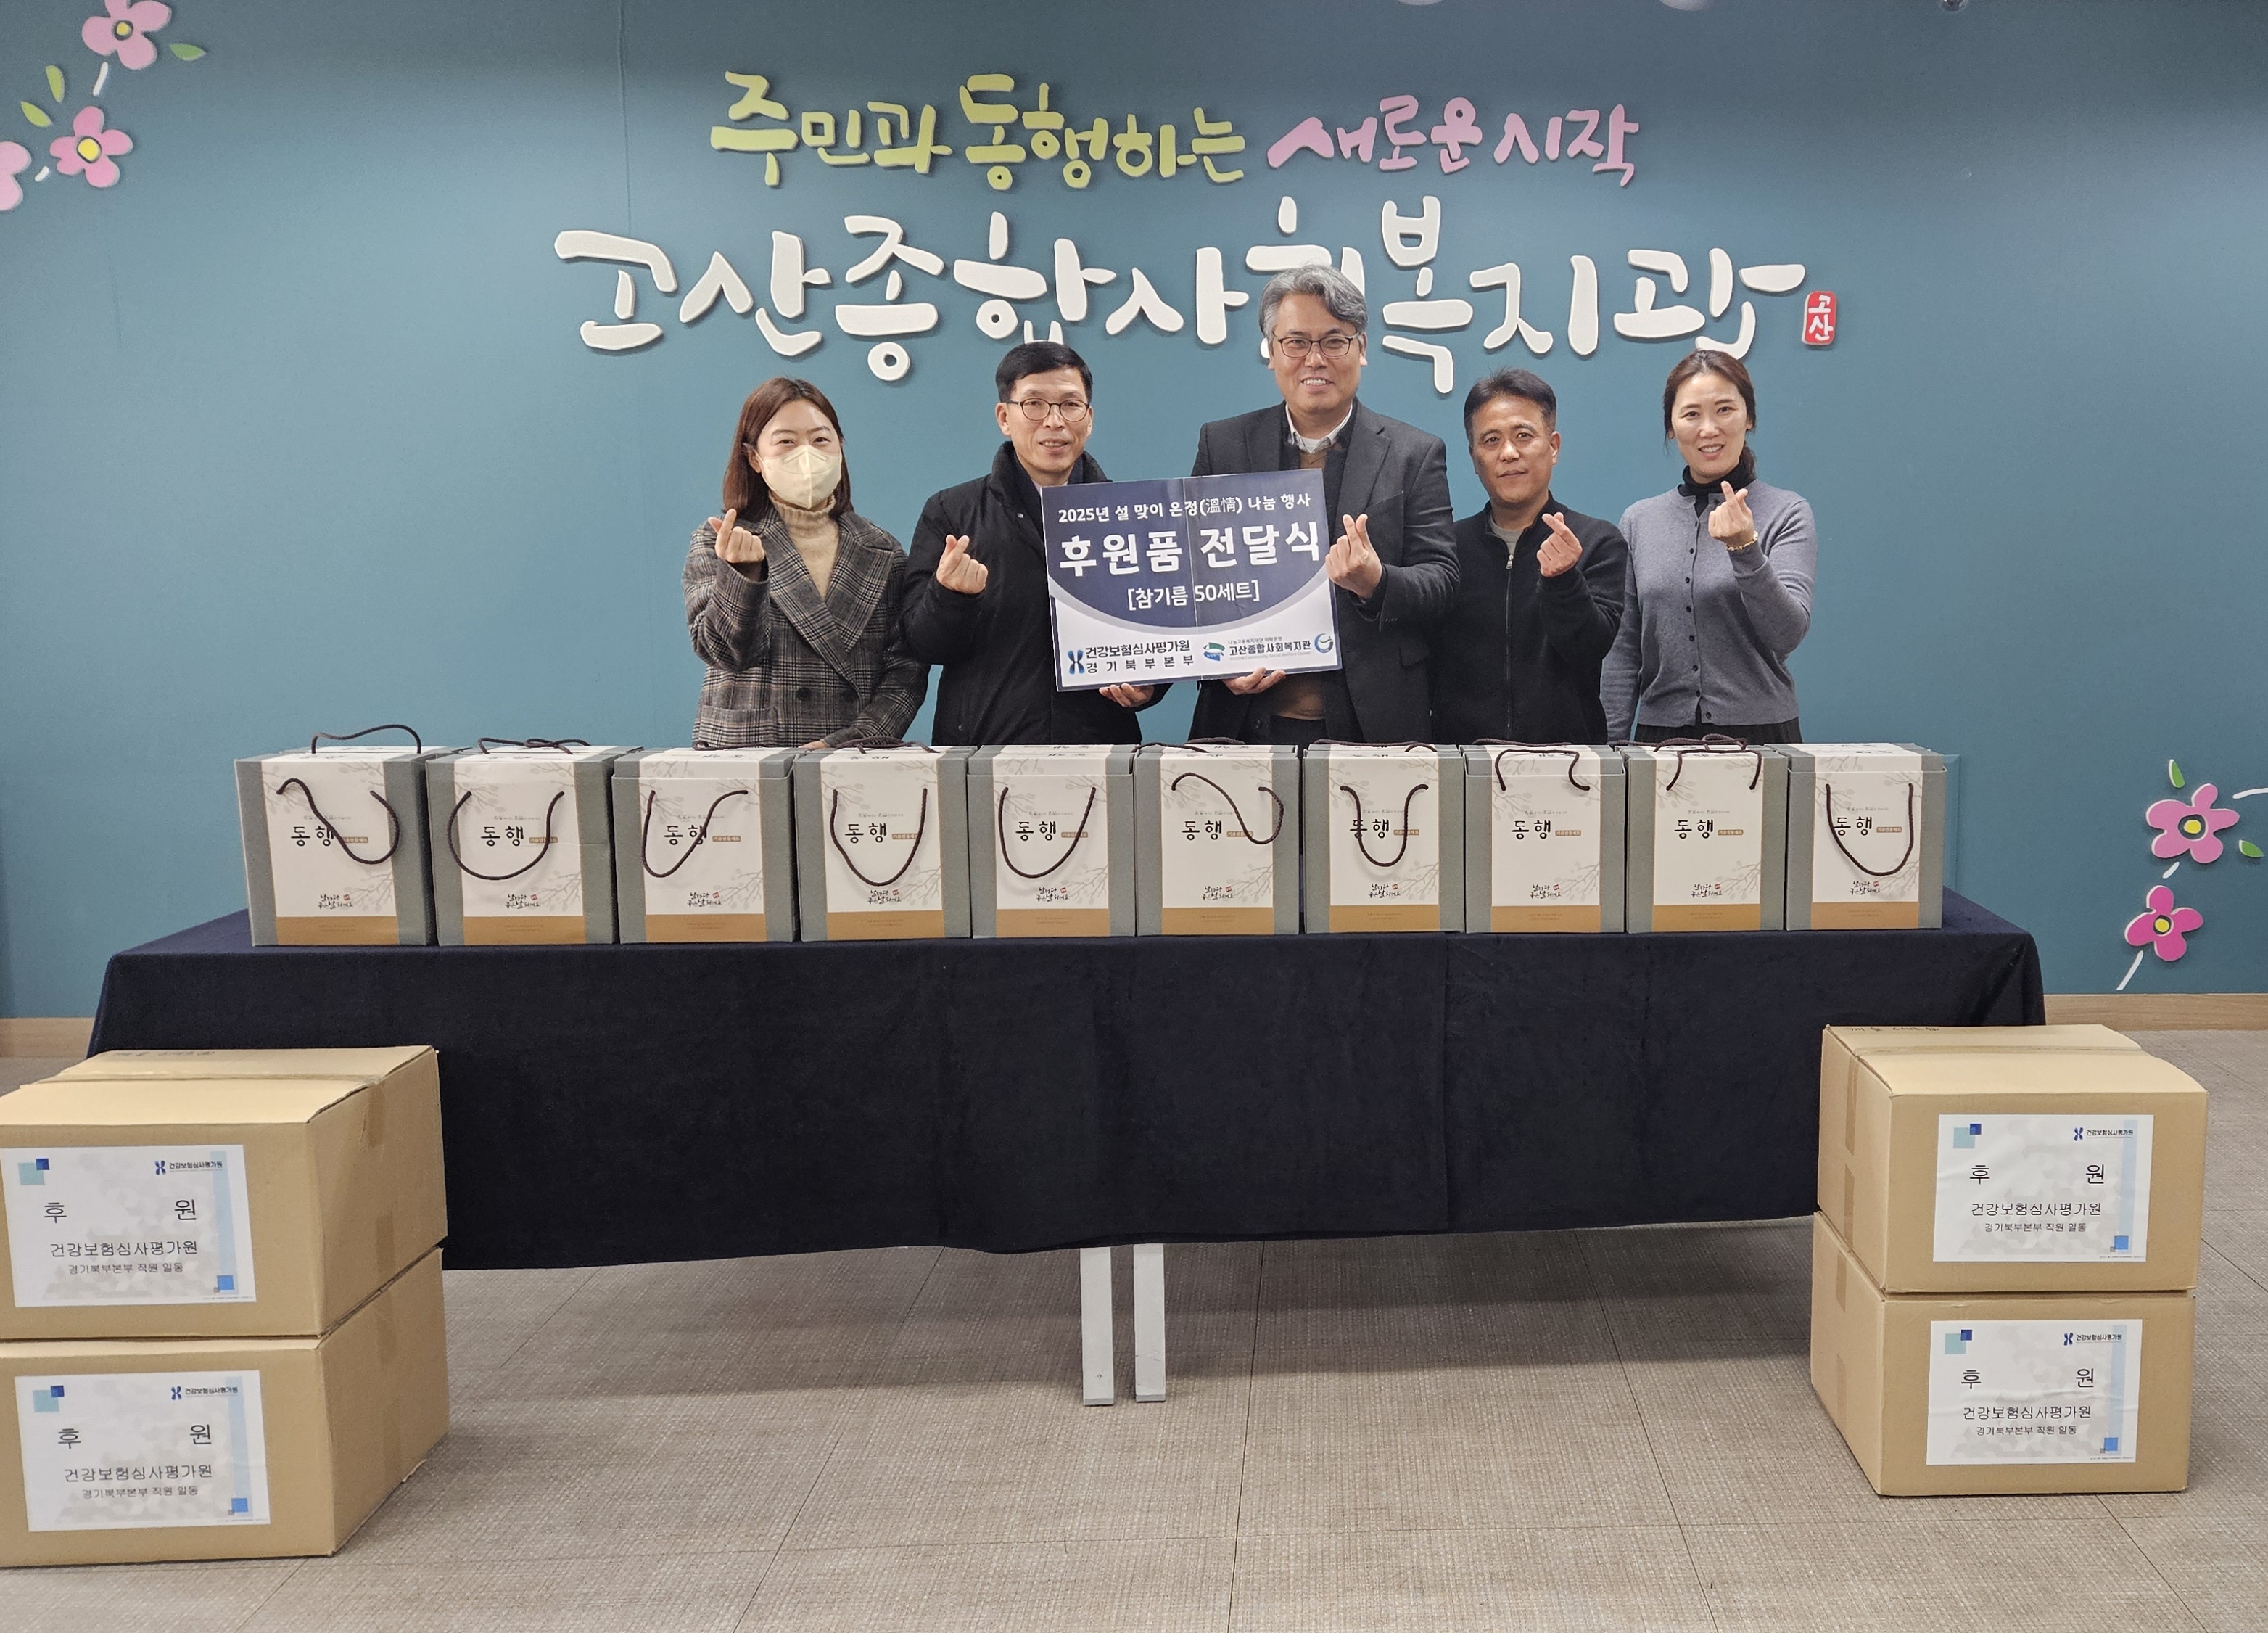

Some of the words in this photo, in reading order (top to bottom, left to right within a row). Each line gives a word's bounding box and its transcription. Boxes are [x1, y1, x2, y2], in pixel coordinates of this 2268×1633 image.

[710, 70, 952, 186] 주민과
[960, 73, 1246, 191] 동행하는
[1267, 94, 1483, 174] 새로운
[1493, 104, 1640, 186] 시작
[1808, 294, 1834, 342] 고산
[1058, 506, 1110, 523] 2025년
[1115, 505, 1129, 521] 설
[1134, 503, 1163, 520] 맞이
[1248, 495, 1276, 513] 나눔
[1281, 493, 1311, 511] 행사
[1060, 531, 1183, 577] 후원품
[1200, 521, 1321, 568] 전달식
[1128, 587, 1189, 611] [참기름
[1194, 580, 1261, 603] 50세트]
[1085, 639, 1191, 659] 건강보험심사평가원
[1229, 641, 1311, 656] 고산종합사회복지관
[480, 825, 524, 847] 동행
[844, 823, 887, 844] 동행
[1015, 820, 1057, 842] 동행
[1181, 820, 1222, 841] 동행
[1511, 819, 1551, 840] 동행
[1674, 818, 1715, 839] 동행
[1971, 1203, 2101, 1216] 건강보험심사평가원
[1984, 1223, 2042, 1232] 경기북부본부
[2045, 1223, 2063, 1232] 직원
[2068, 1223, 2086, 1232] 일동
[51, 1241, 198, 1257] 건강보험심사평가원
[69, 1264, 133, 1275] 경기북부본부
[137, 1264, 157, 1273] 직원
[162, 1262, 183, 1273] 일동
[1963, 1406, 2091, 1420] 건강보험심사평가원
[1976, 1426, 2034, 1436] 경기북부본부
[2037, 1426, 2055, 1435] 직원
[2058, 1426, 2077, 1435] 일동
[65, 1465, 213, 1482] 건강보험심사평가원
[83, 1488, 147, 1499] 경기북부본부
[153, 1487, 173, 1496] 직원
[177, 1486, 198, 1496] 일동
